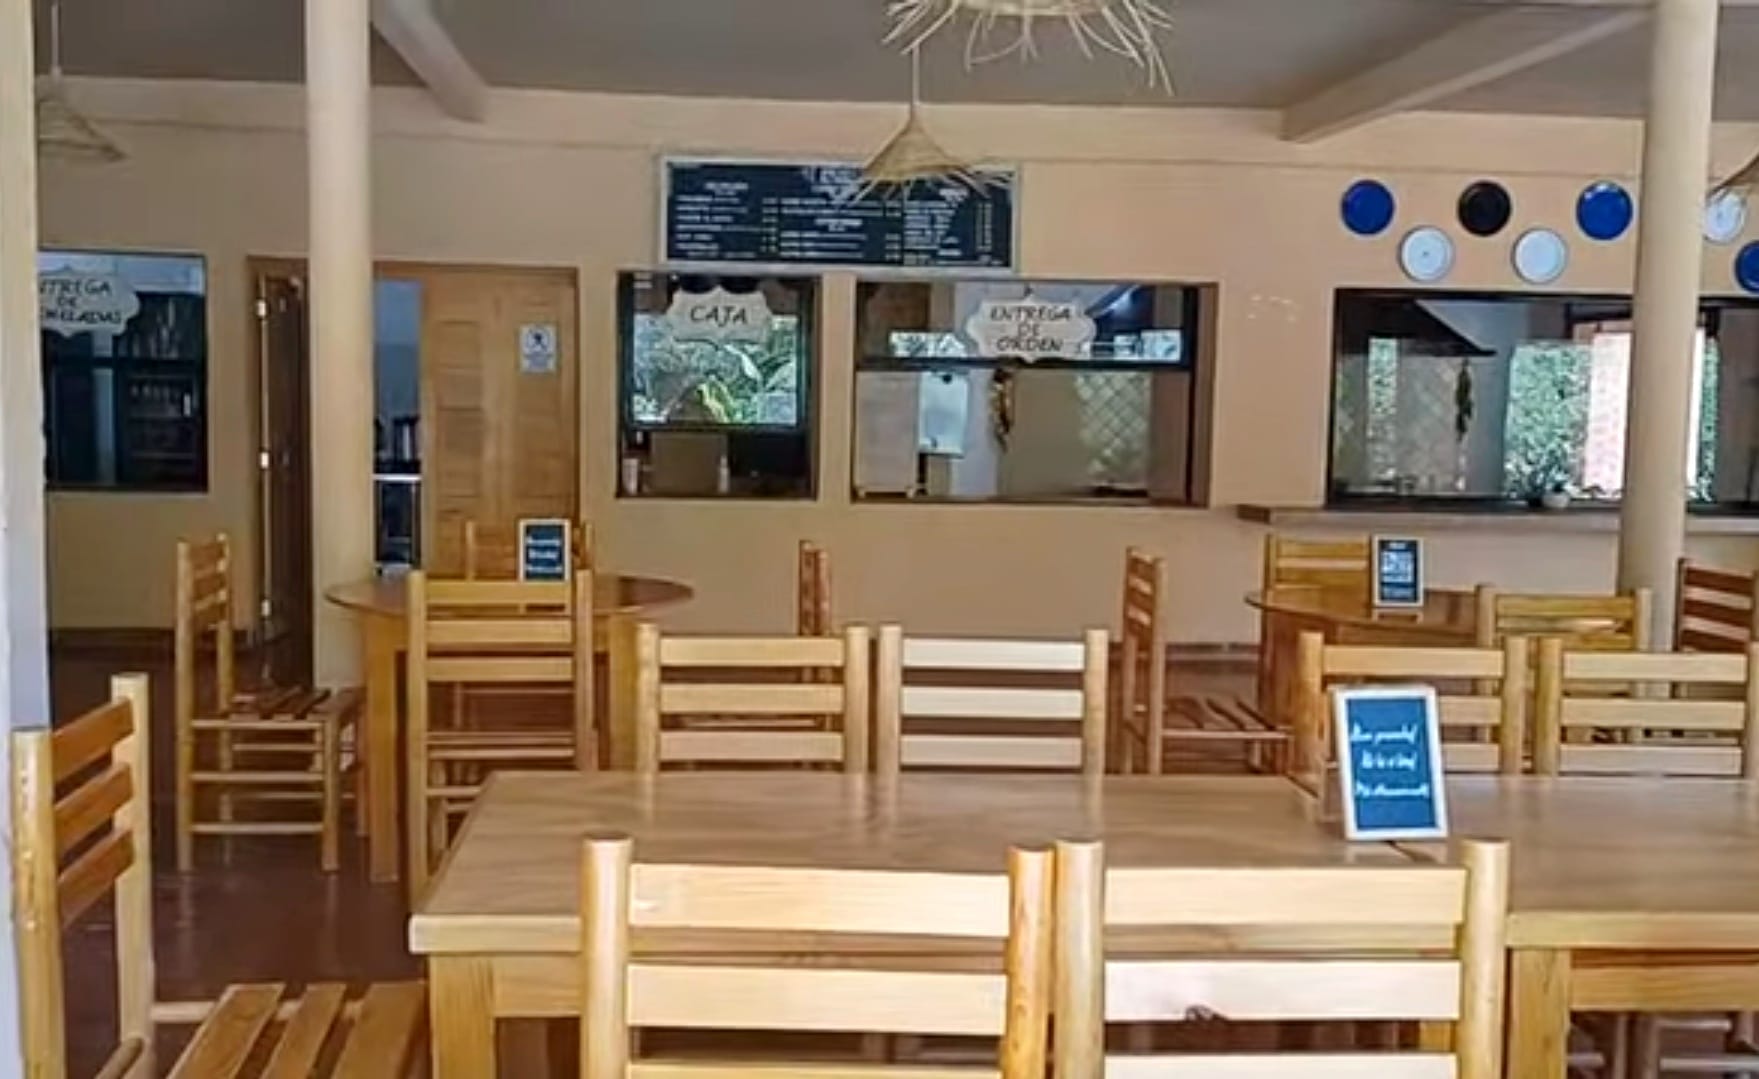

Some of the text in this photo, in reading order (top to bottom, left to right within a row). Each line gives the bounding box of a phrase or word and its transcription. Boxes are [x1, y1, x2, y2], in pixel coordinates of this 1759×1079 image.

[690, 304, 749, 327] CAJA
[990, 304, 1071, 322] ENTREGA
[1017, 323, 1042, 337] DE
[996, 336, 1064, 352] ORDEN
